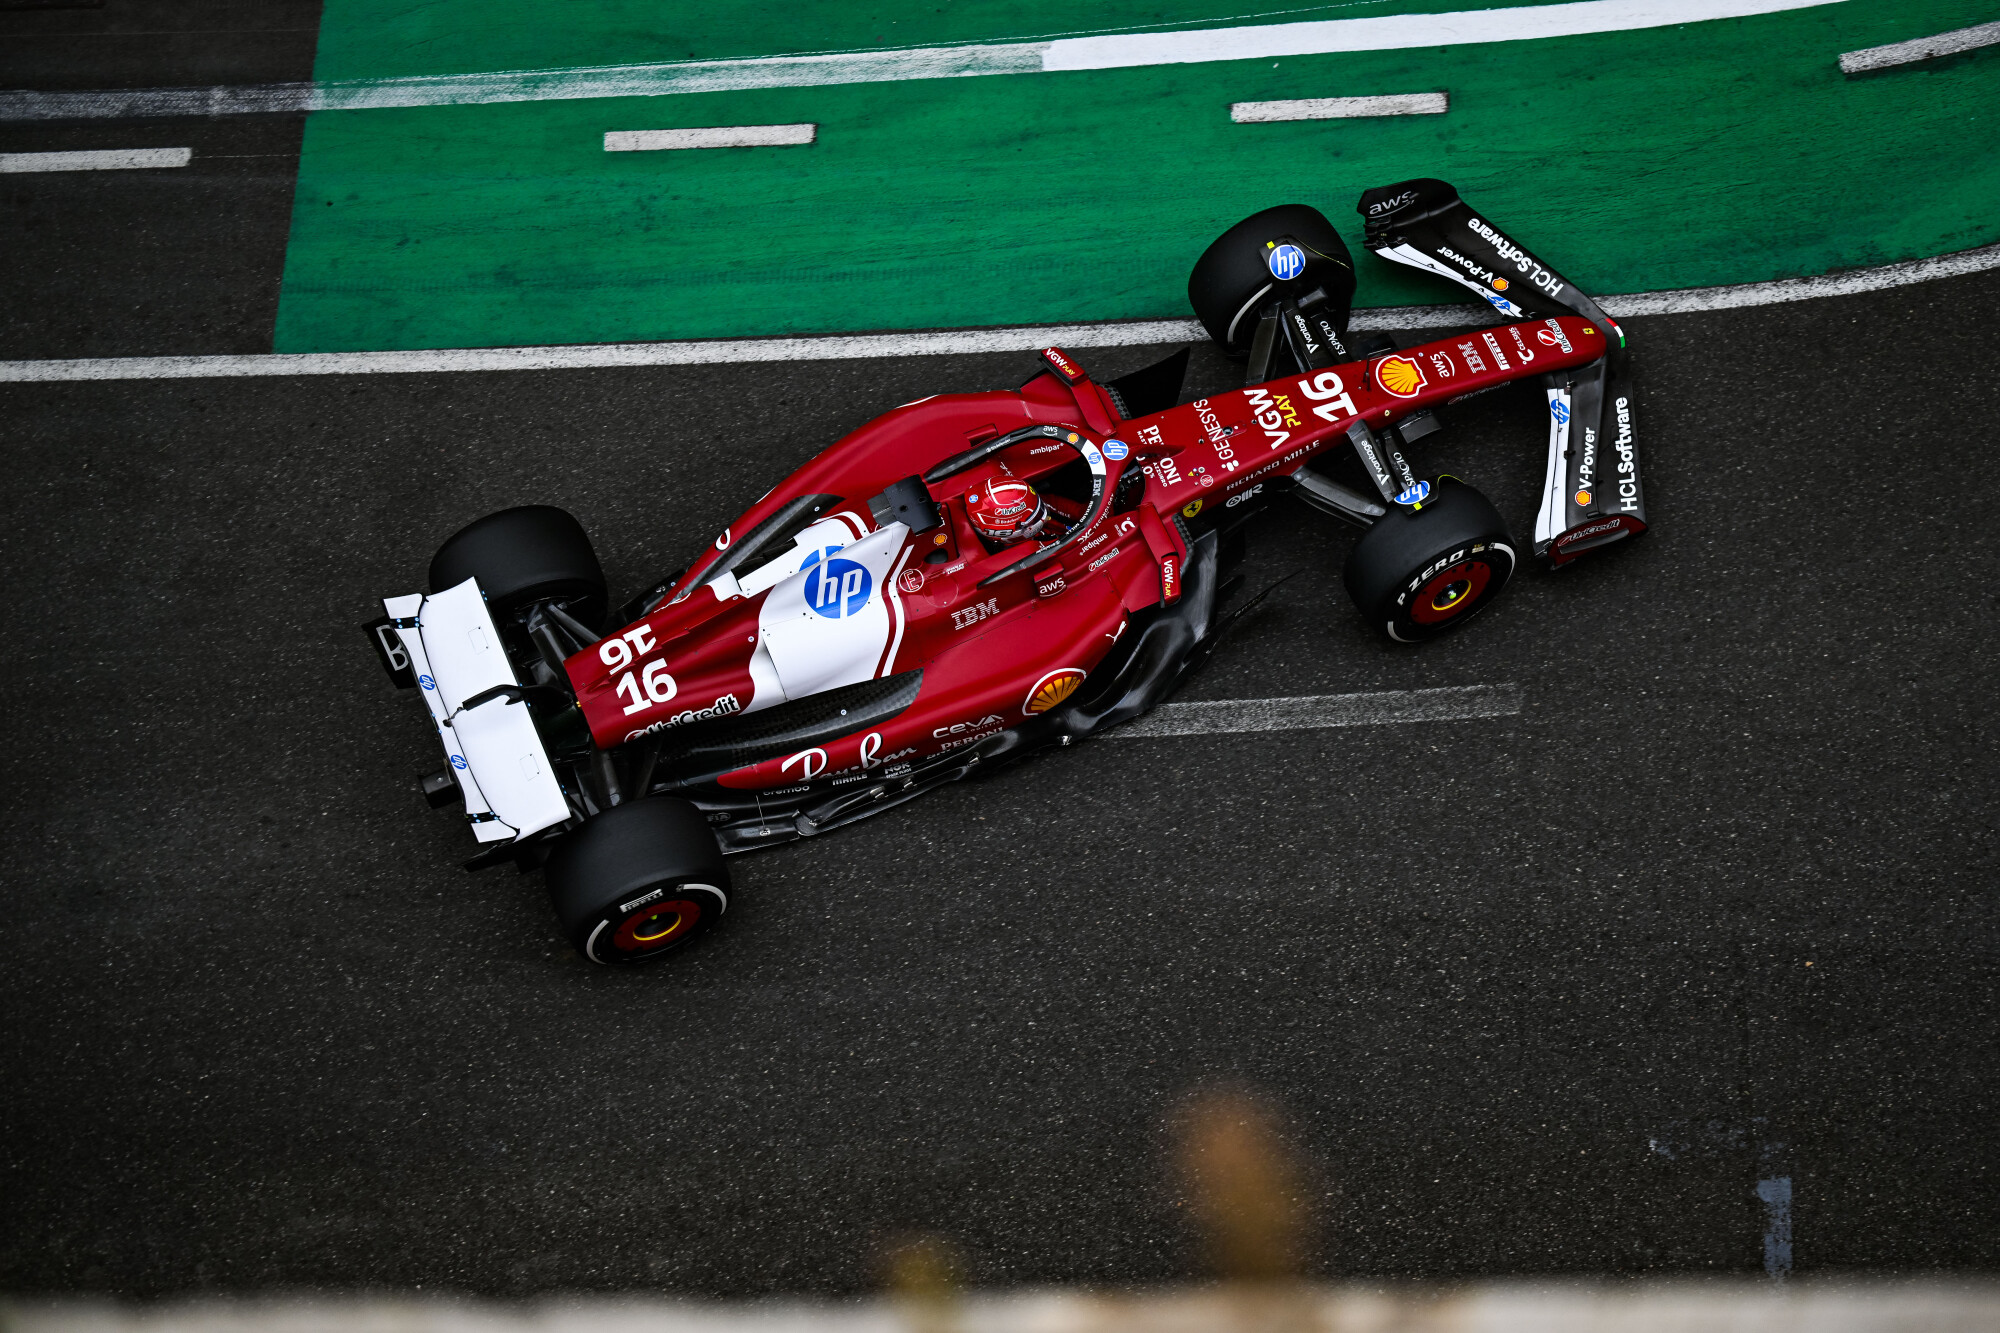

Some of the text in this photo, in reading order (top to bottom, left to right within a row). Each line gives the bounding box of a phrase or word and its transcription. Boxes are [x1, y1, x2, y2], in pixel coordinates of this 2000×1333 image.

[1274, 246, 1302, 279] hp
[1437, 245, 1493, 284] V-Power
[1467, 217, 1564, 298] HCLSoftware
[1045, 347, 1067, 367] VGW
[1430, 352, 1455, 378] aws
[1457, 341, 1487, 374] IBM
[1482, 332, 1511, 371] PIRELLI
[1298, 371, 1358, 422] 16
[1193, 399, 1234, 461] GENESYS
[1243, 388, 1302, 450] VGW PLAY
[1104, 441, 1128, 459] hp
[1142, 424, 1182, 486] PEONI
[1226, 460, 1280, 491] RICHARD
[1283, 439, 1320, 462] MILLE
[1361, 440, 1383, 474] vantage
[1578, 426, 1596, 489] V-Power
[1615, 396, 1638, 512] HCLSoftware
[1093, 478, 1102, 497] IBM
[1393, 452, 1417, 487] SPACIO
[812, 559, 868, 619] hp
[1039, 577, 1067, 597] aws
[1163, 559, 1174, 583] VGW
[1408, 549, 1465, 592] ZERO
[951, 597, 1000, 631] IBM
[599, 623, 656, 675] 16
[420, 674, 435, 690] hp
[616, 657, 678, 716] 16
[941, 726, 1004, 751] PERONI
[451, 754, 467, 770] hp
